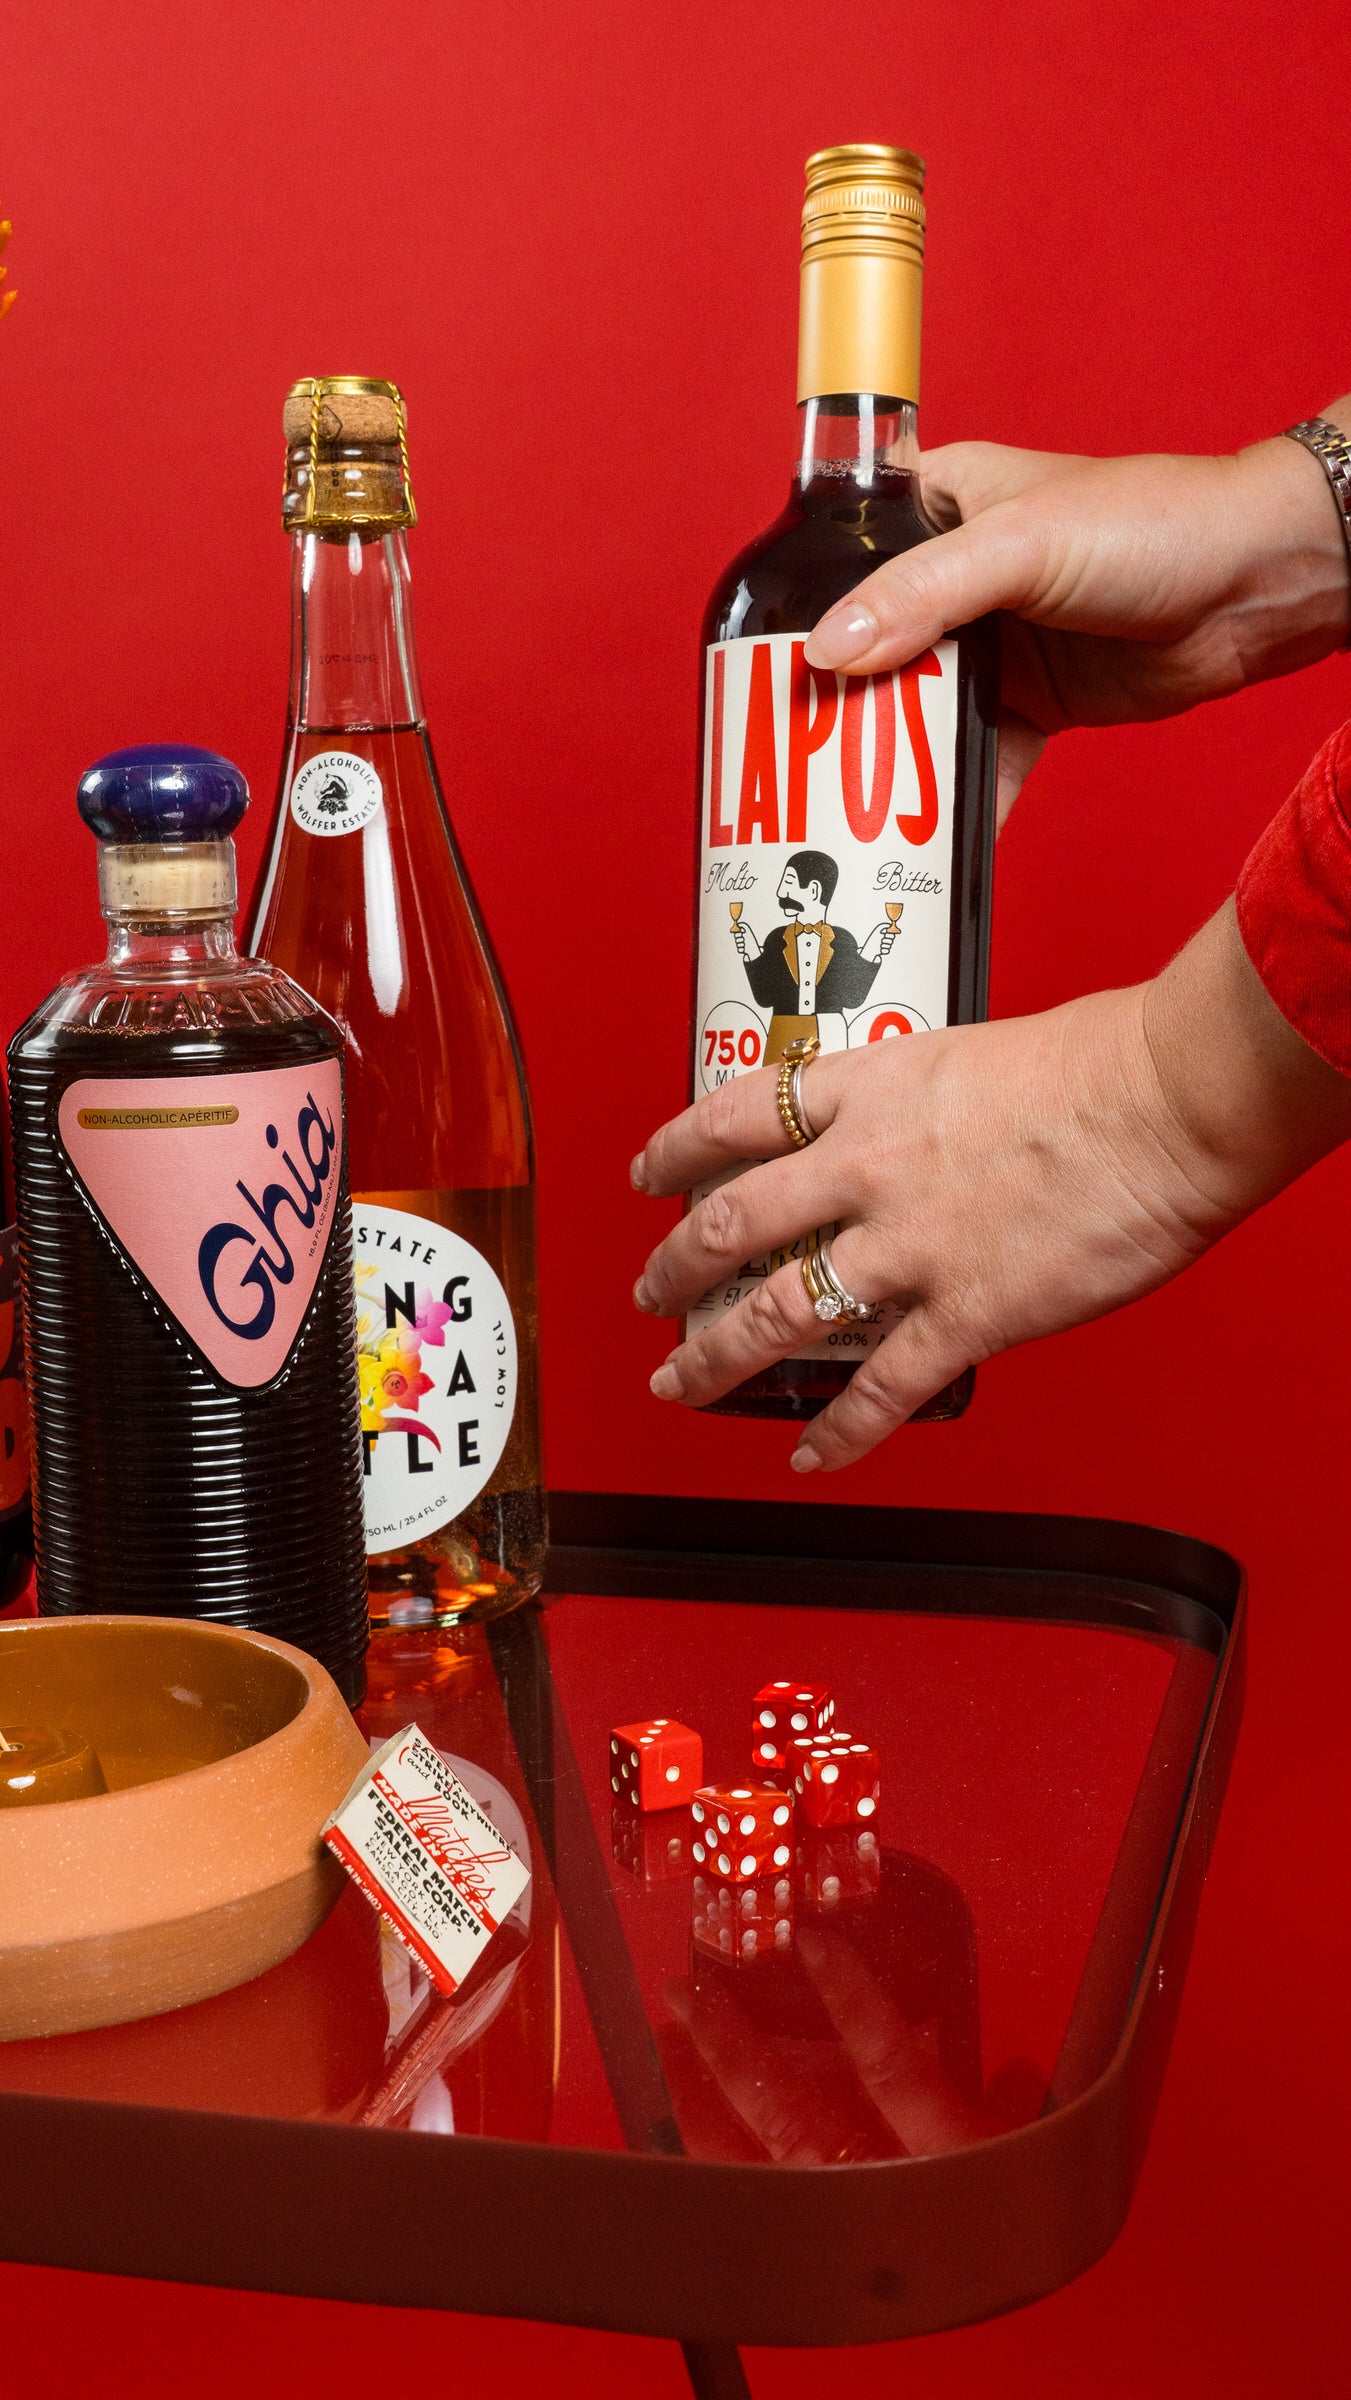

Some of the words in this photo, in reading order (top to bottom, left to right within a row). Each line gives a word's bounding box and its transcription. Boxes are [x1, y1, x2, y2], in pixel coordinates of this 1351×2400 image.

[709, 641, 942, 848] LAPOS
[298, 757, 376, 791] NON-ALCOHOLIC
[298, 804, 336, 830] WÖLFFER
[342, 800, 376, 828] ESTATE
[705, 861, 758, 893] Molto
[873, 861, 943, 894] Bitter
[704, 1029, 761, 1067] 750
[84, 1112, 177, 1125] NON-ALCOHOLIC
[179, 1109, 232, 1123] APÉRITIF
[198, 1091, 335, 1340] Ghia
[315, 1226, 322, 1240] FL
[318, 1212, 326, 1227] OZ
[308, 1240, 318, 1258] 16.9
[357, 1227, 436, 1265] STATE
[828, 1333, 868, 1346] 0.0%
[494, 1368, 506, 1408] LOW
[362, 1419, 480, 1475] TLE
[383, 1523, 397, 1533] ML
[404, 1511, 424, 1526] 25.4
[424, 1505, 435, 1516] FL
[435, 1495, 448, 1508] OZ
[412, 1749, 451, 1788] STRIKE
[407, 1758, 430, 1780] and
[434, 1781, 469, 1820] BOOK
[364, 1841, 395, 1884] KANSAS
[367, 1789, 429, 1872] FEDERAL
[430, 1871, 481, 1936] MATCH
[373, 1831, 397, 1860] NEW
[376, 1778, 420, 1832] MADE
[420, 1835, 442, 1859] IN
[441, 1862, 485, 1919] U.S.A.
[404, 1795, 511, 1908] Matches
[374, 1816, 421, 1877] SALES
[422, 1879, 462, 1933] CORP.
